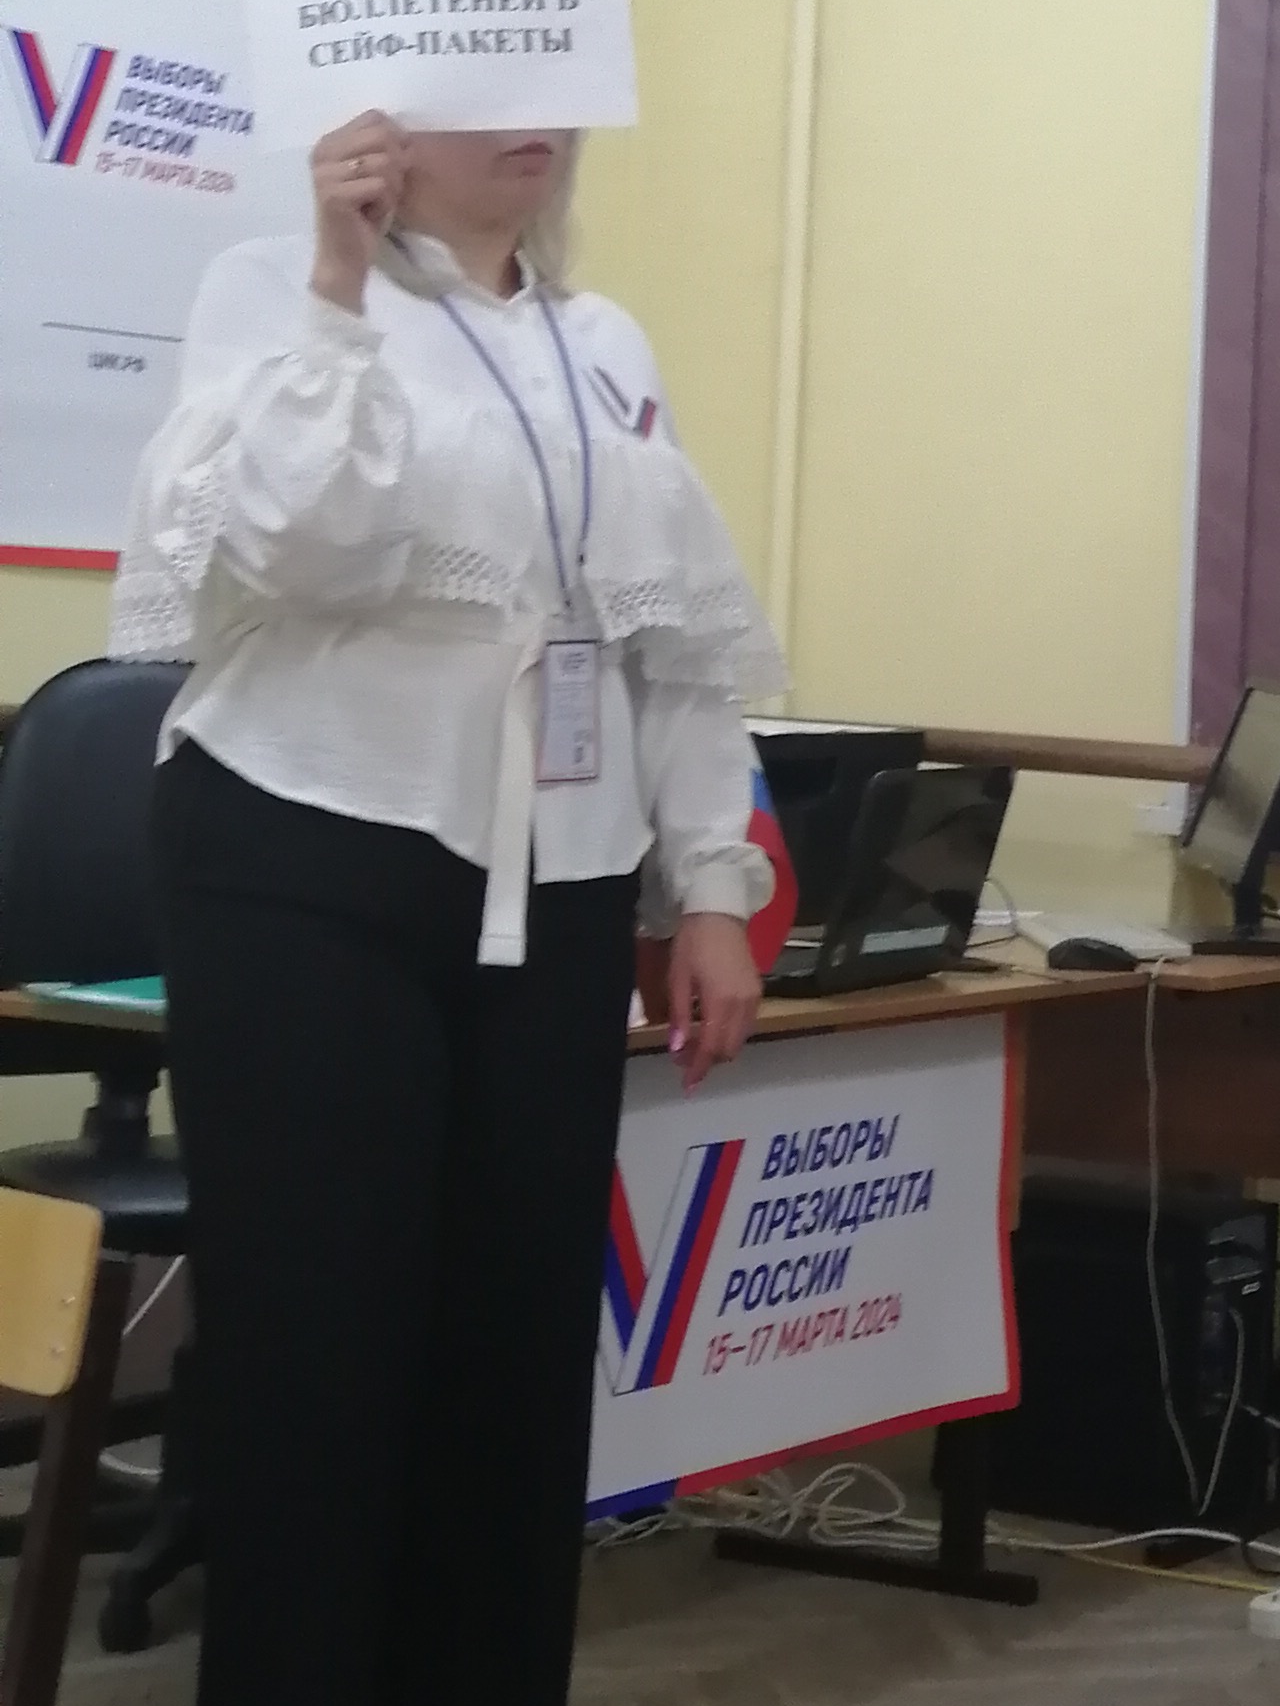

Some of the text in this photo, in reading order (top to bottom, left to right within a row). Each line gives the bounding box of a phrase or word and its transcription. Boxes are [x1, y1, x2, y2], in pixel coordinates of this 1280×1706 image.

[126, 54, 230, 94] ВЫБОРЫ
[308, 28, 573, 69] СЕЙФ-ПАКЕТЫ
[104, 119, 199, 158] РОССИИ
[115, 86, 255, 137] ПРЕЗИДЕНТА
[762, 1114, 901, 1180] ВЫБОРЫ
[739, 1168, 935, 1248] ПРЕЗИДЕНТА
[717, 1245, 852, 1317] РОССИИ
[774, 1306, 851, 1360] МАРТА
[850, 1292, 904, 1342] 2024
